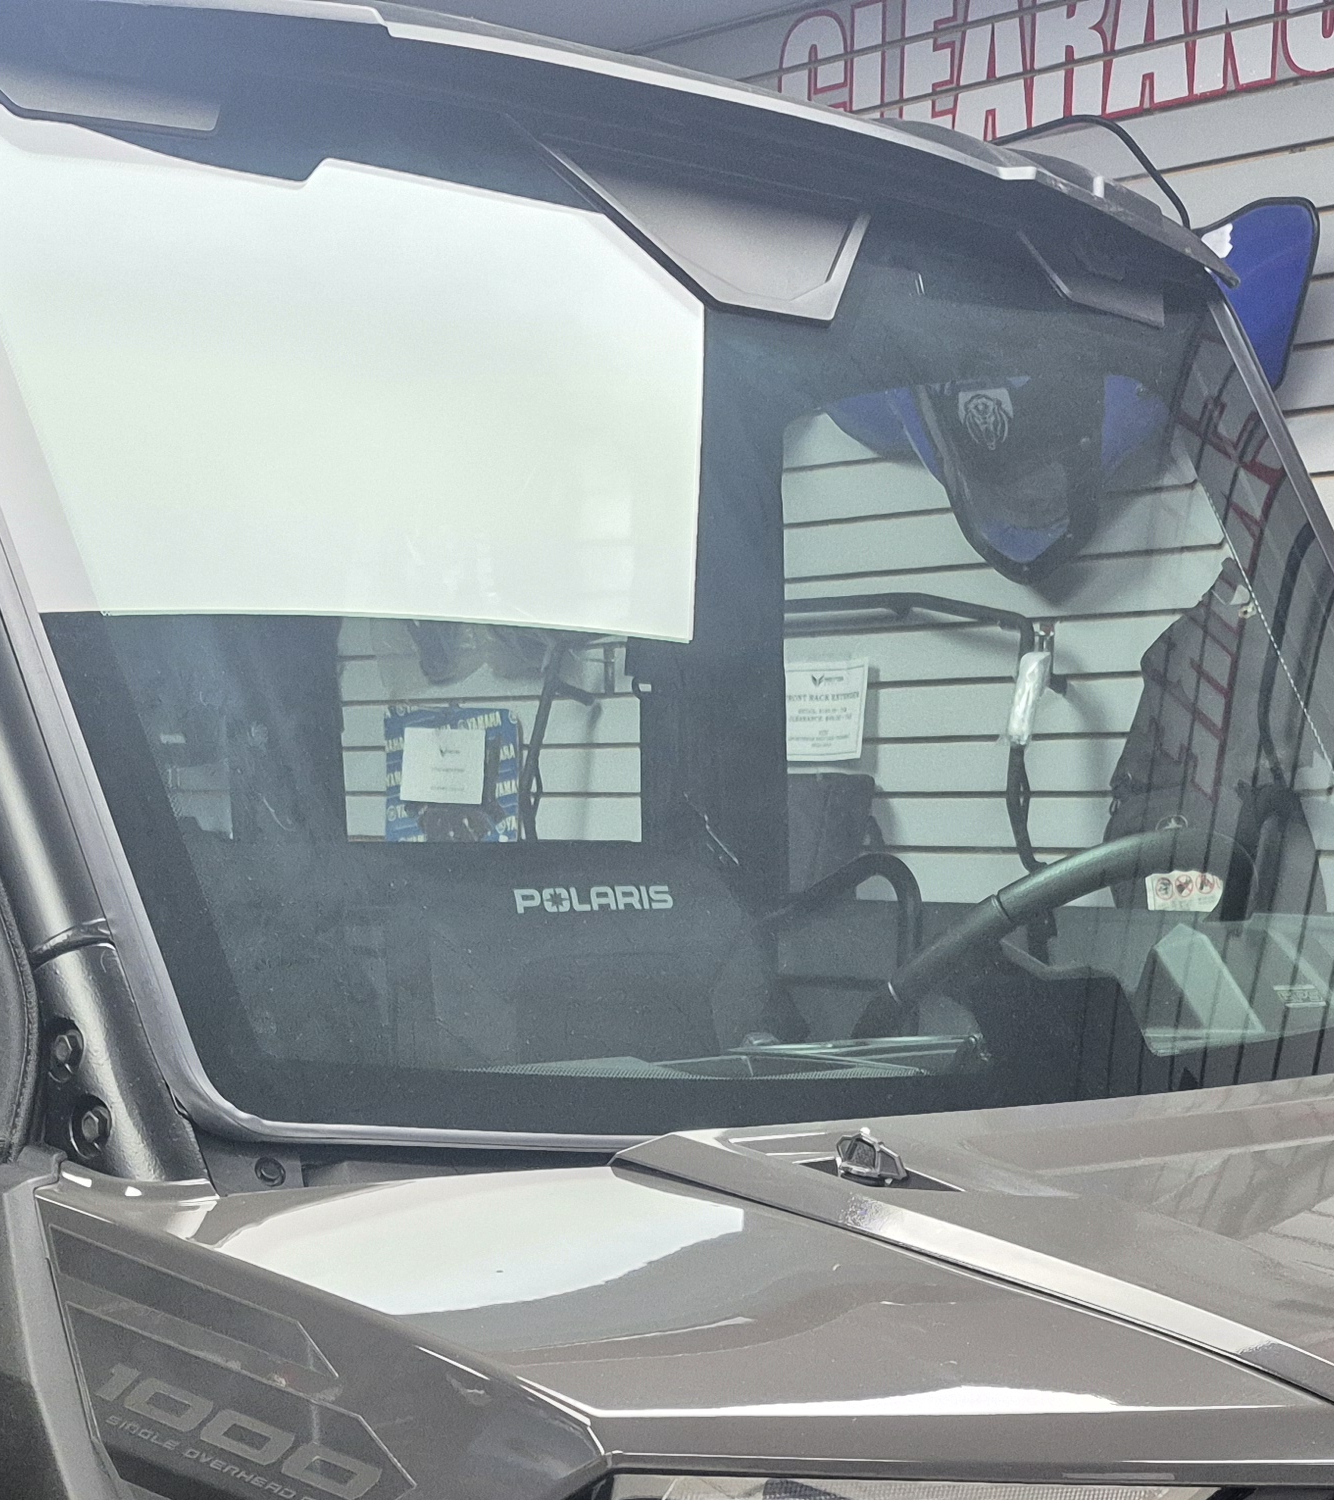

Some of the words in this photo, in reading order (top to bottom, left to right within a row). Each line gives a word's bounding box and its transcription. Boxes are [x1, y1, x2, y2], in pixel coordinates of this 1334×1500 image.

[514, 883, 673, 914] POLARIS
[94, 1362, 383, 1500] 1000
[105, 1413, 177, 1451] SINGLE
[183, 1447, 297, 1499] OVERHEAD
